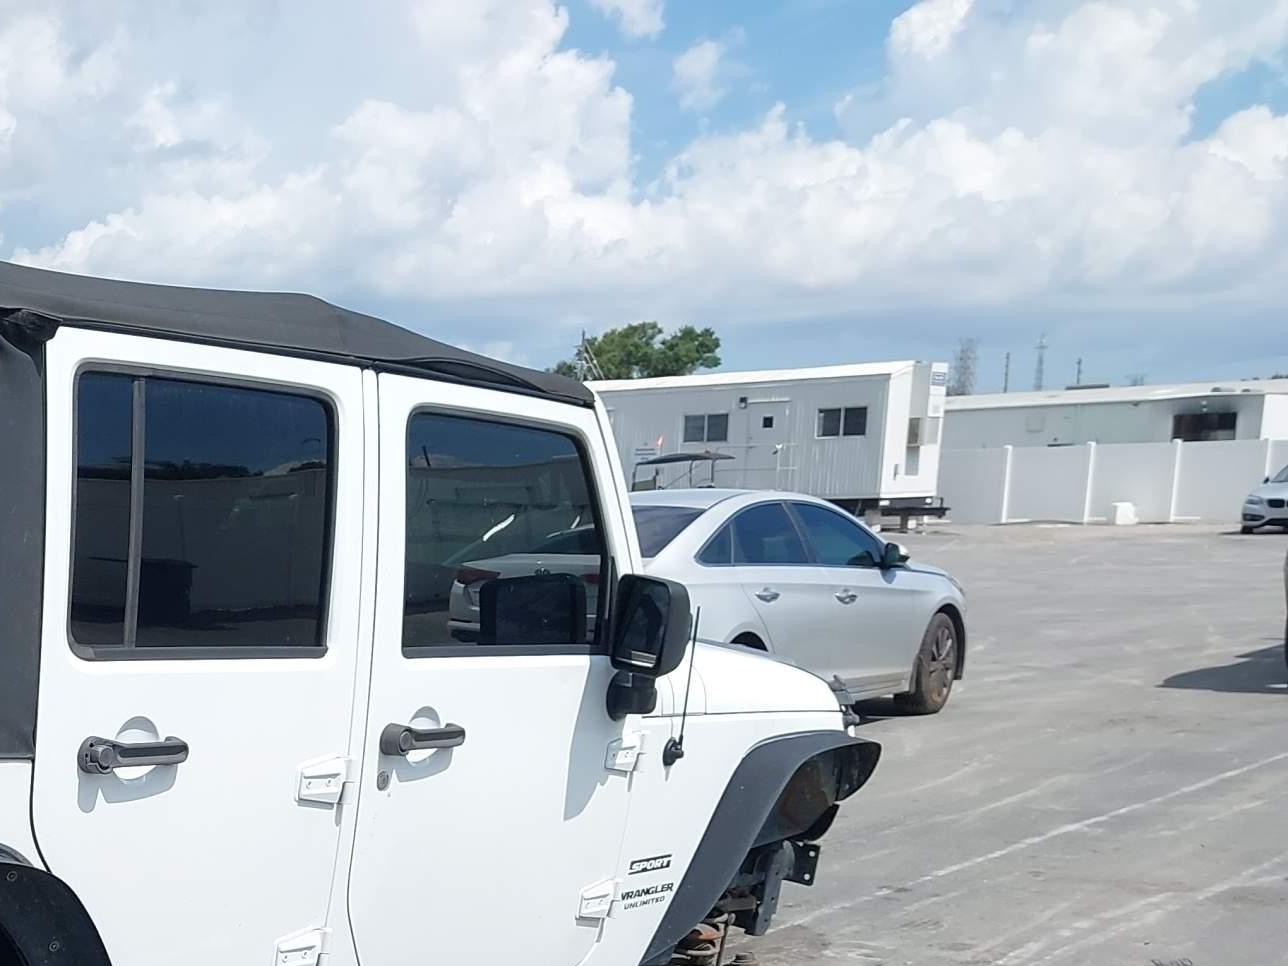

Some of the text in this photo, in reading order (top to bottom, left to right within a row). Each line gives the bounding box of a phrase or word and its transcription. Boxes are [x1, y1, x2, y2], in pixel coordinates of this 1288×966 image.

[629, 855, 672, 874] SPORT
[621, 882, 674, 901] WRANGLER
[623, 895, 665, 910] UNLIMITED
